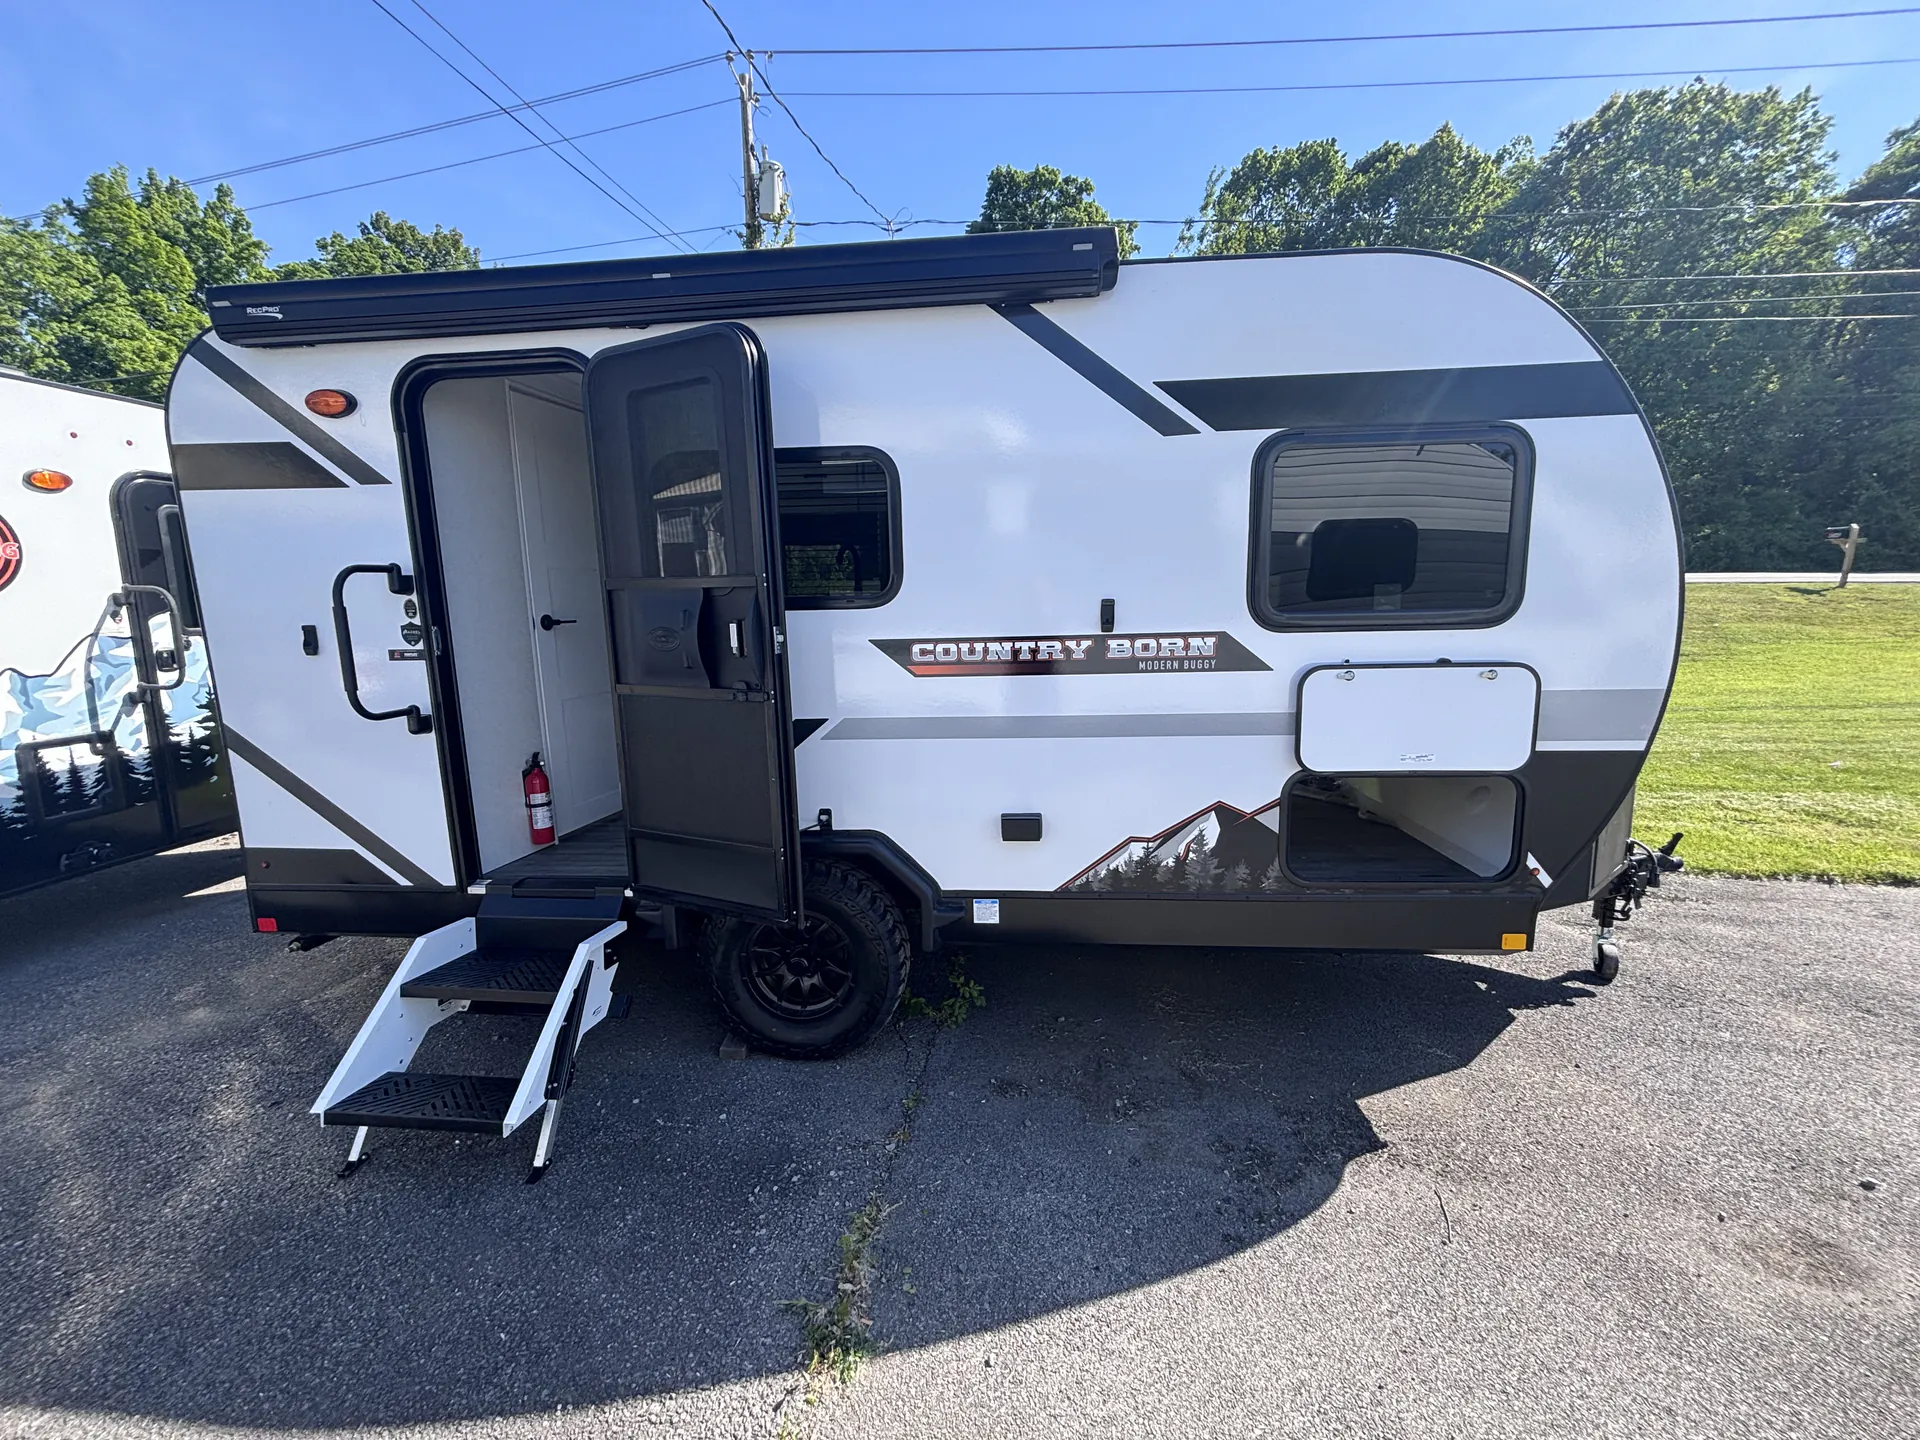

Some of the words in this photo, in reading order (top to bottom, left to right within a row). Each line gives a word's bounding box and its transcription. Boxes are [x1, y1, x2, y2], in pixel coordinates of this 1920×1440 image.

[910, 639, 1094, 663] COUNTRY
[1105, 635, 1218, 659] BORN
[1138, 660, 1179, 671] MODERN
[1183, 659, 1217, 670] BUGGY
